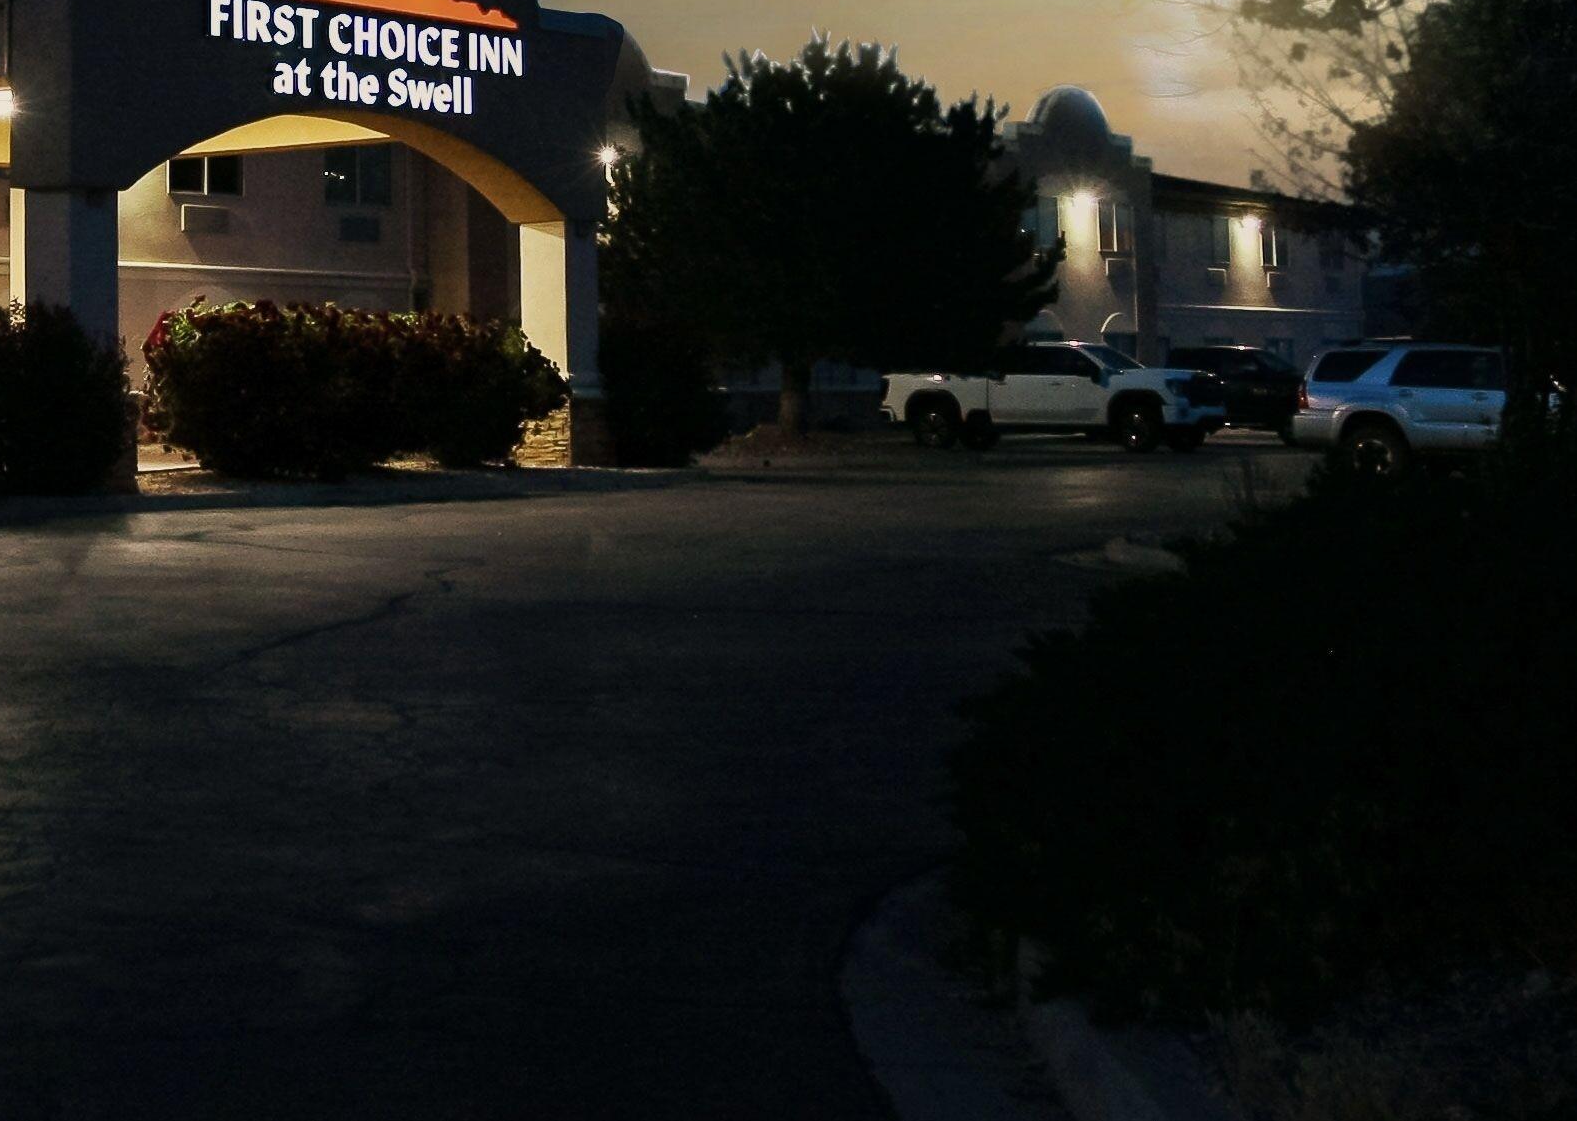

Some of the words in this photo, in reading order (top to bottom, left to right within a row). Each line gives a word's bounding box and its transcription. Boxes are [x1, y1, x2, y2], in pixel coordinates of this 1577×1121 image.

[328, 13, 460, 69] CHOICE
[468, 32, 523, 77] INN
[273, 57, 312, 97] at
[320, 60, 380, 105] the
[387, 67, 473, 115] Swell
